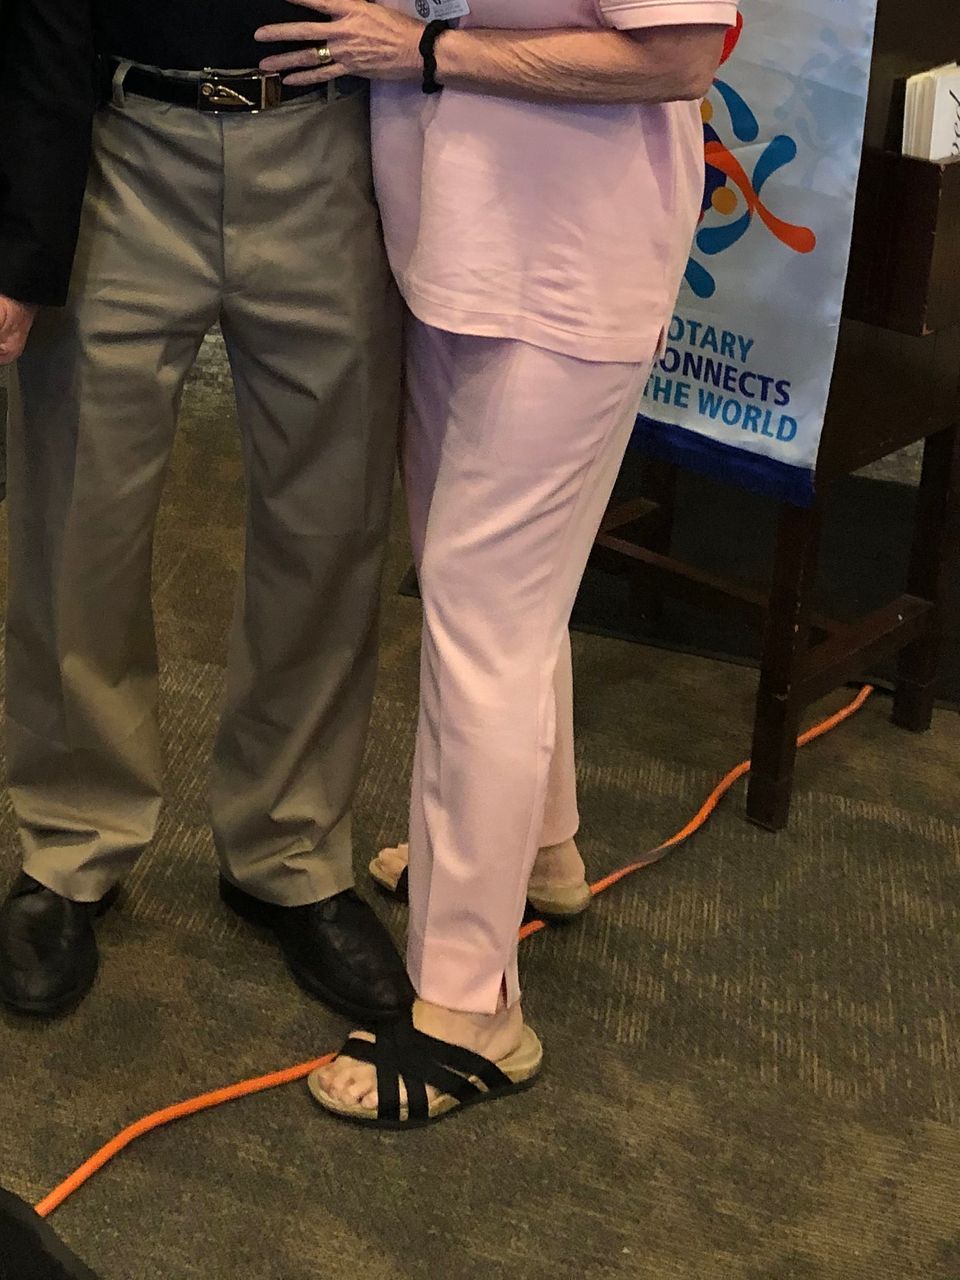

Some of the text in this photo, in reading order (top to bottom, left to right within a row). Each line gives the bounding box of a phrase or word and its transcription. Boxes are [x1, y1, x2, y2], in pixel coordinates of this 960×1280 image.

[667, 315, 754, 363] OTARY
[653, 347, 791, 407] ONNECTS
[698, 388, 798, 442] WORLD
